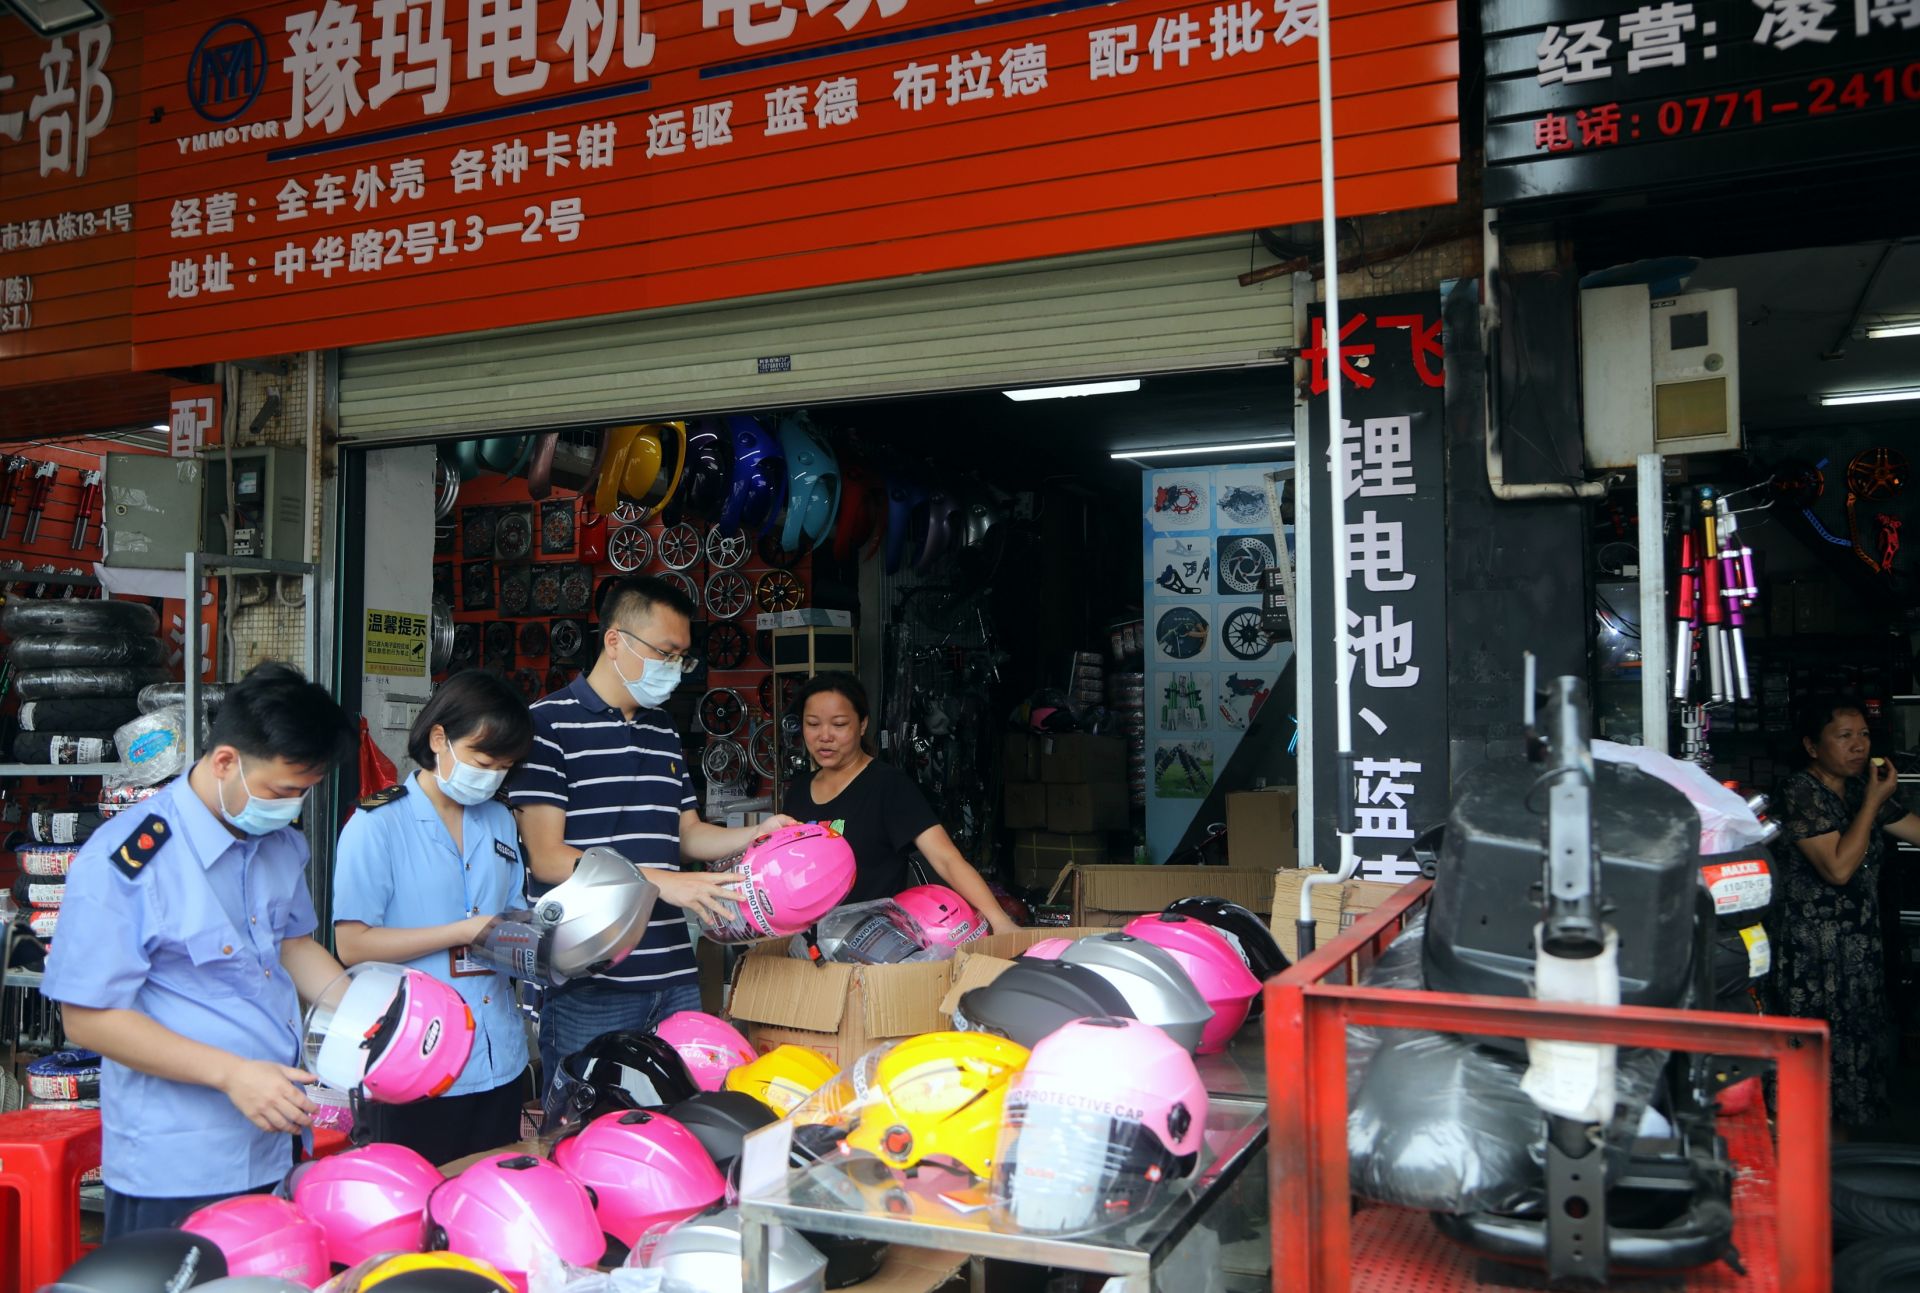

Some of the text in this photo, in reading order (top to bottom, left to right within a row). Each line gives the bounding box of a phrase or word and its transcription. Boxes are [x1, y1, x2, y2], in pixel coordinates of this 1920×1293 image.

[282, 0, 655, 140] 豫玛电机
[449, 121, 617, 193] 各种卡钳
[645, 100, 734, 160] 远驱
[763, 76, 859, 138] 蓝德
[893, 42, 1050, 111] 布拉德
[176, 120, 279, 154] YMMOTOR
[368, 613, 426, 637] 温馨提示
[951, 922, 969, 940] DAVID
[1022, 1089, 1112, 1114] PROTECTIVE
[1114, 1104, 1144, 1120] CAP
